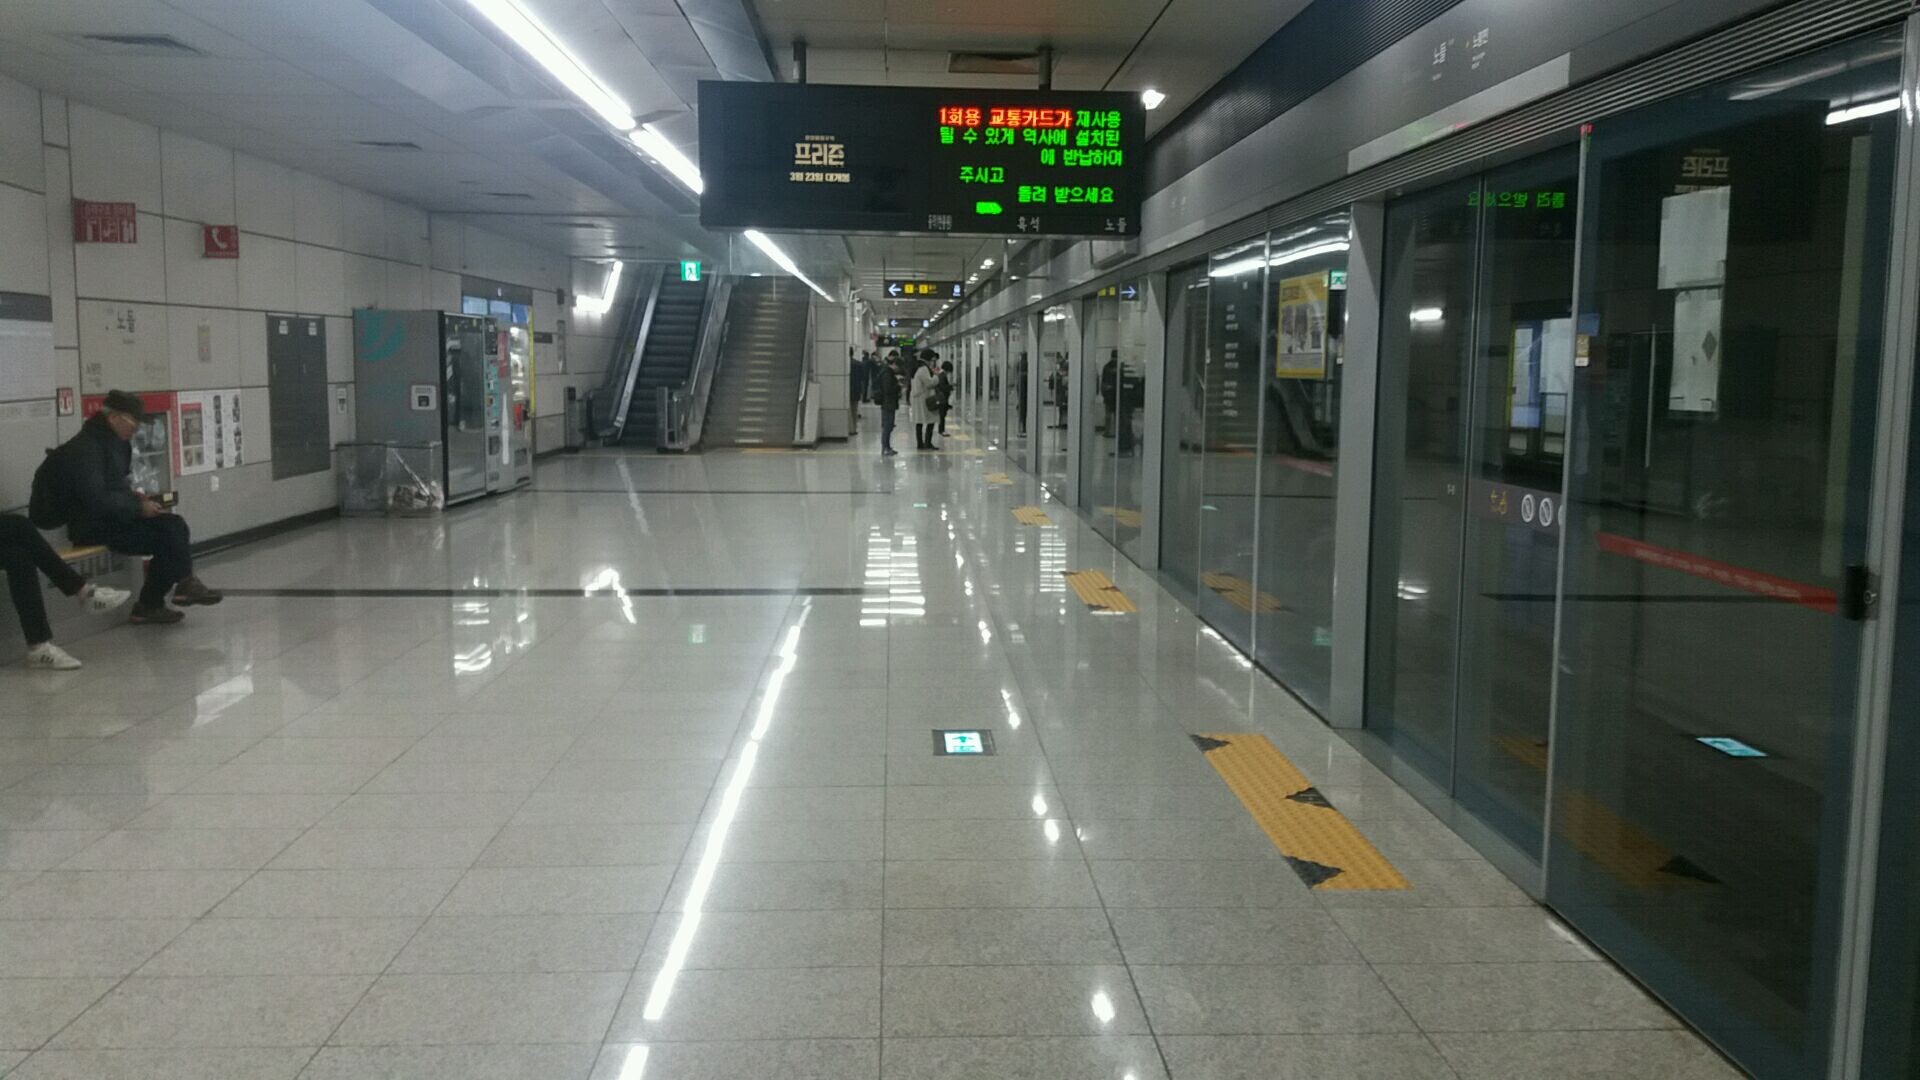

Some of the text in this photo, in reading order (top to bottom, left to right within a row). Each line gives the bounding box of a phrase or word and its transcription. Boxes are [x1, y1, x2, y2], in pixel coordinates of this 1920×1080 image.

[939, 107, 1121, 129] 1회용 교통카드가 재사용
[963, 127, 978, 145] 수
[985, 127, 1015, 145] 있게
[1023, 128, 1067, 146] 역사에
[1075, 130, 1120, 147] 설치된
[794, 143, 845, 166] 프리즌
[1040, 148, 1124, 167] 에 반납하여
[960, 165, 1004, 184] 주시고
[1017, 185, 1115, 204] 돌려 받으세요
